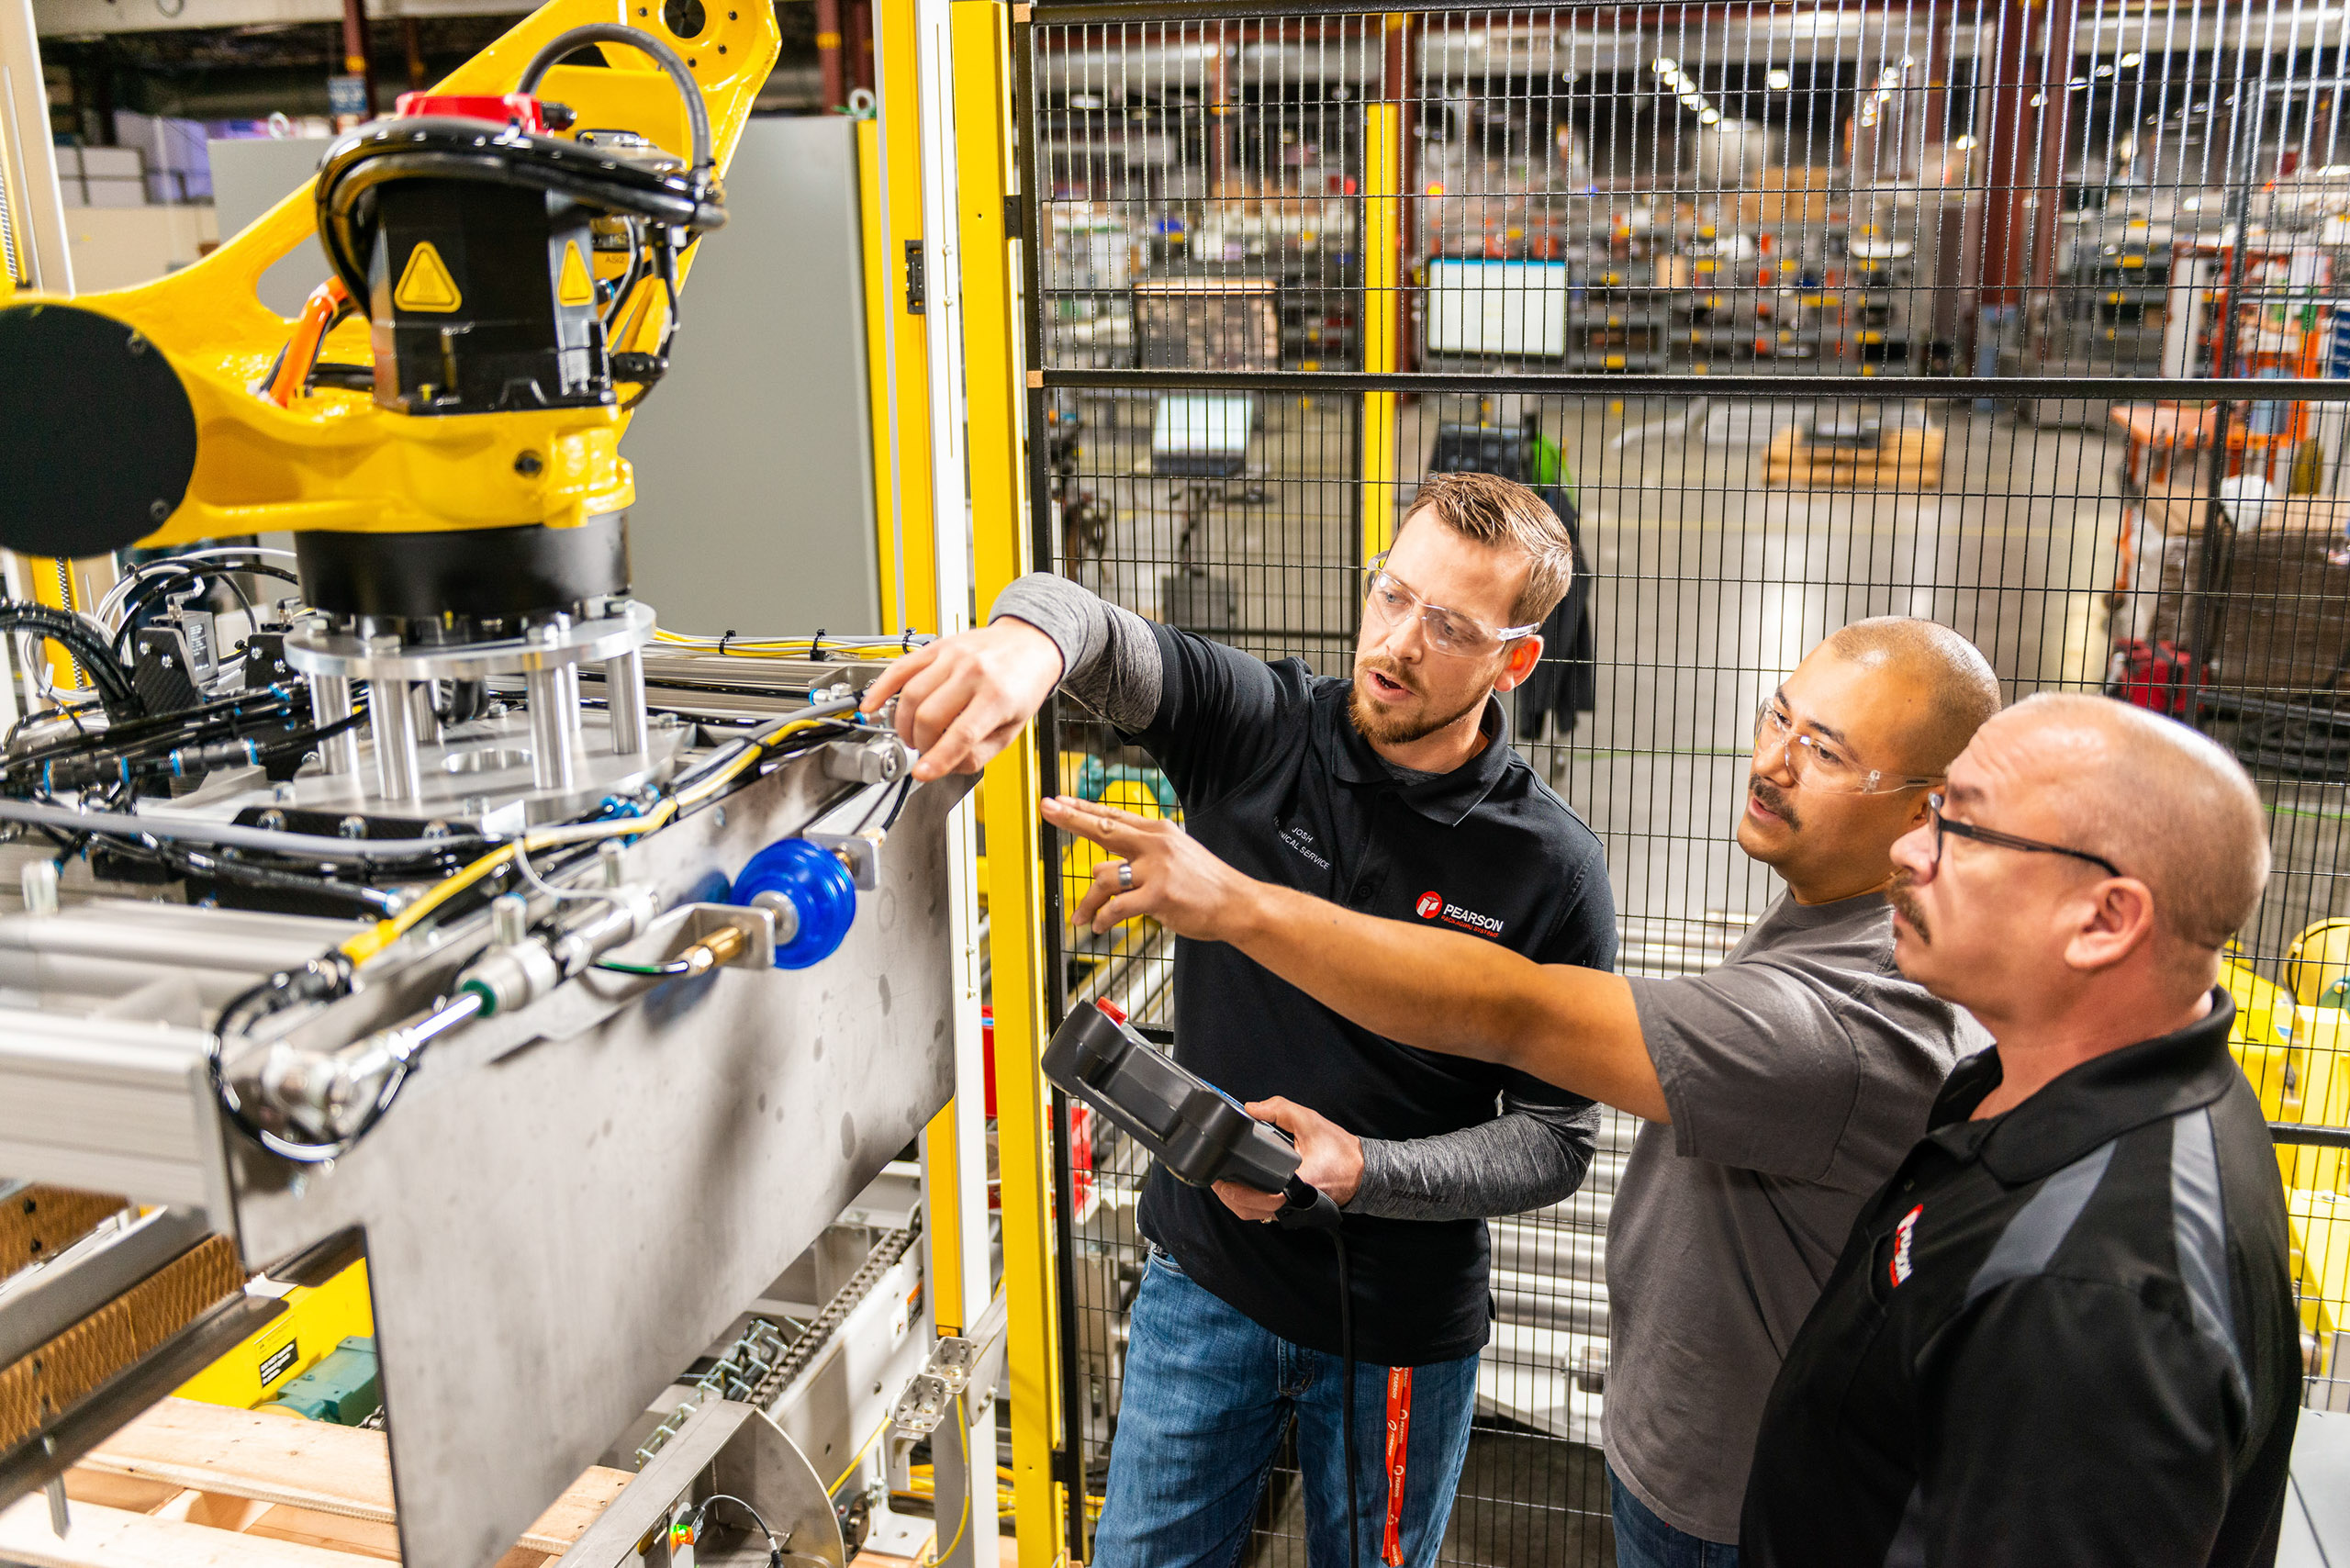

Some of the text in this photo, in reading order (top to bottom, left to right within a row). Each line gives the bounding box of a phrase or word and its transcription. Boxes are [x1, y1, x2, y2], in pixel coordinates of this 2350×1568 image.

[1292, 827, 1313, 843] JOSH
[1300, 846, 1329, 869] SERVICE
[1443, 903, 1504, 932] PEARSON
[1472, 926, 1499, 937] SYSTEMS
